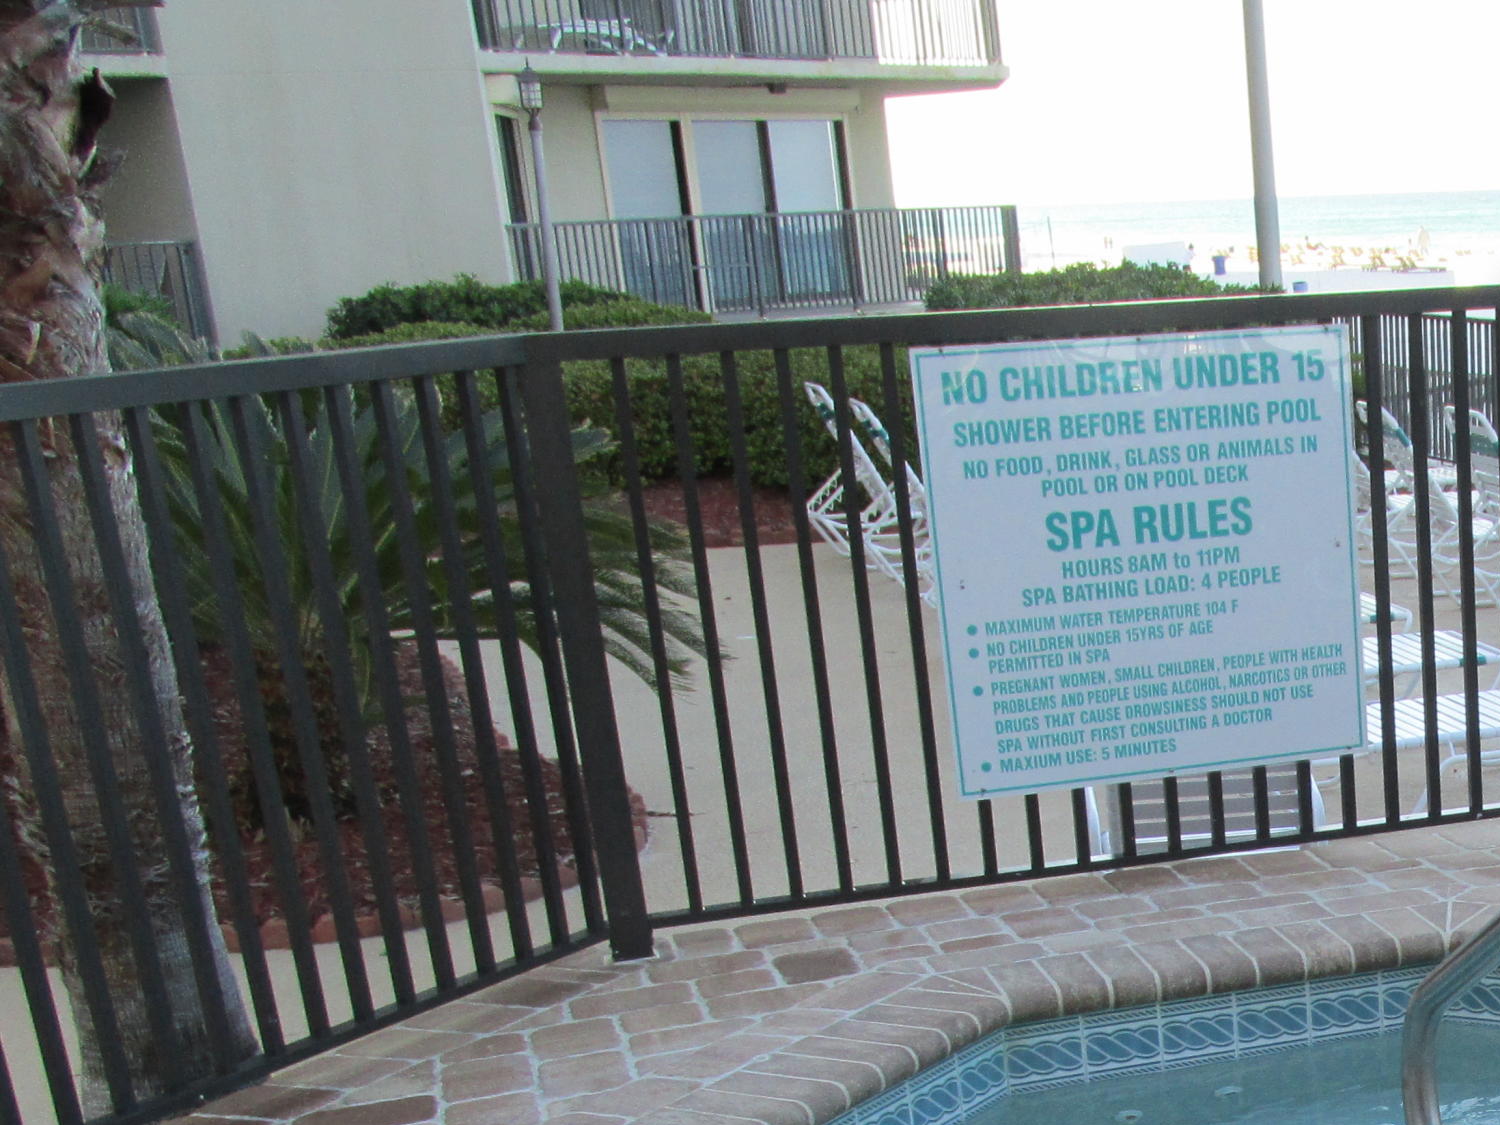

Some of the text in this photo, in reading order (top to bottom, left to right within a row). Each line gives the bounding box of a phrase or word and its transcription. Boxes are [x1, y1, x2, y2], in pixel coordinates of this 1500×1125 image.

[941, 350, 1325, 405] NO CHILDREN UNDER 15
[954, 399, 1321, 447] SHOWER BEFORE ENTERING POOL
[963, 460, 988, 479] NO
[1126, 445, 1181, 467] GLASS
[1187, 444, 1210, 462] OR
[1217, 437, 1294, 459] ANIMALS
[1301, 435, 1318, 452] IN
[1042, 464, 1248, 497] POOL OR ON POOL DECK
[1045, 497, 1253, 552] SPA RULES
[1062, 546, 1240, 579] HOURS 8AM to 11PM
[1022, 566, 1281, 607] SPA BATHING LOAD: 4 PEOPLE
[985, 599, 1239, 636] MAXIMUM WATER TEMPERATURE 104 F
[987, 620, 1213, 657] NO CHILDREN UNDER 15YRS OF AGE
[989, 648, 1110, 674] PERMITTED IN SPA
[991, 676, 1054, 696] PREGNANT
[1115, 665, 1154, 682] SMALL
[1223, 652, 1265, 670] PEOPLE
[1269, 648, 1298, 665] WITH
[1302, 643, 1343, 662] HEALTH
[993, 695, 1057, 715] PROBLEMS
[1061, 692, 1084, 708] AND
[1088, 687, 1130, 705] PEOPLE
[1134, 682, 1168, 699] USING
[1229, 668, 1290, 688] NARCOTICS
[1294, 666, 1309, 680] OR
[1312, 661, 1347, 678] OTHER
[995, 684, 1314, 735] DRUGS THAT CAUSE DROWSINESS SHOULD NOT USE
[997, 707, 1272, 754] SPA WITHOUT FIRST CONSULTING A DOCTOR
[1000, 738, 1176, 773] MAXIUM USE: 5 MINUTES
